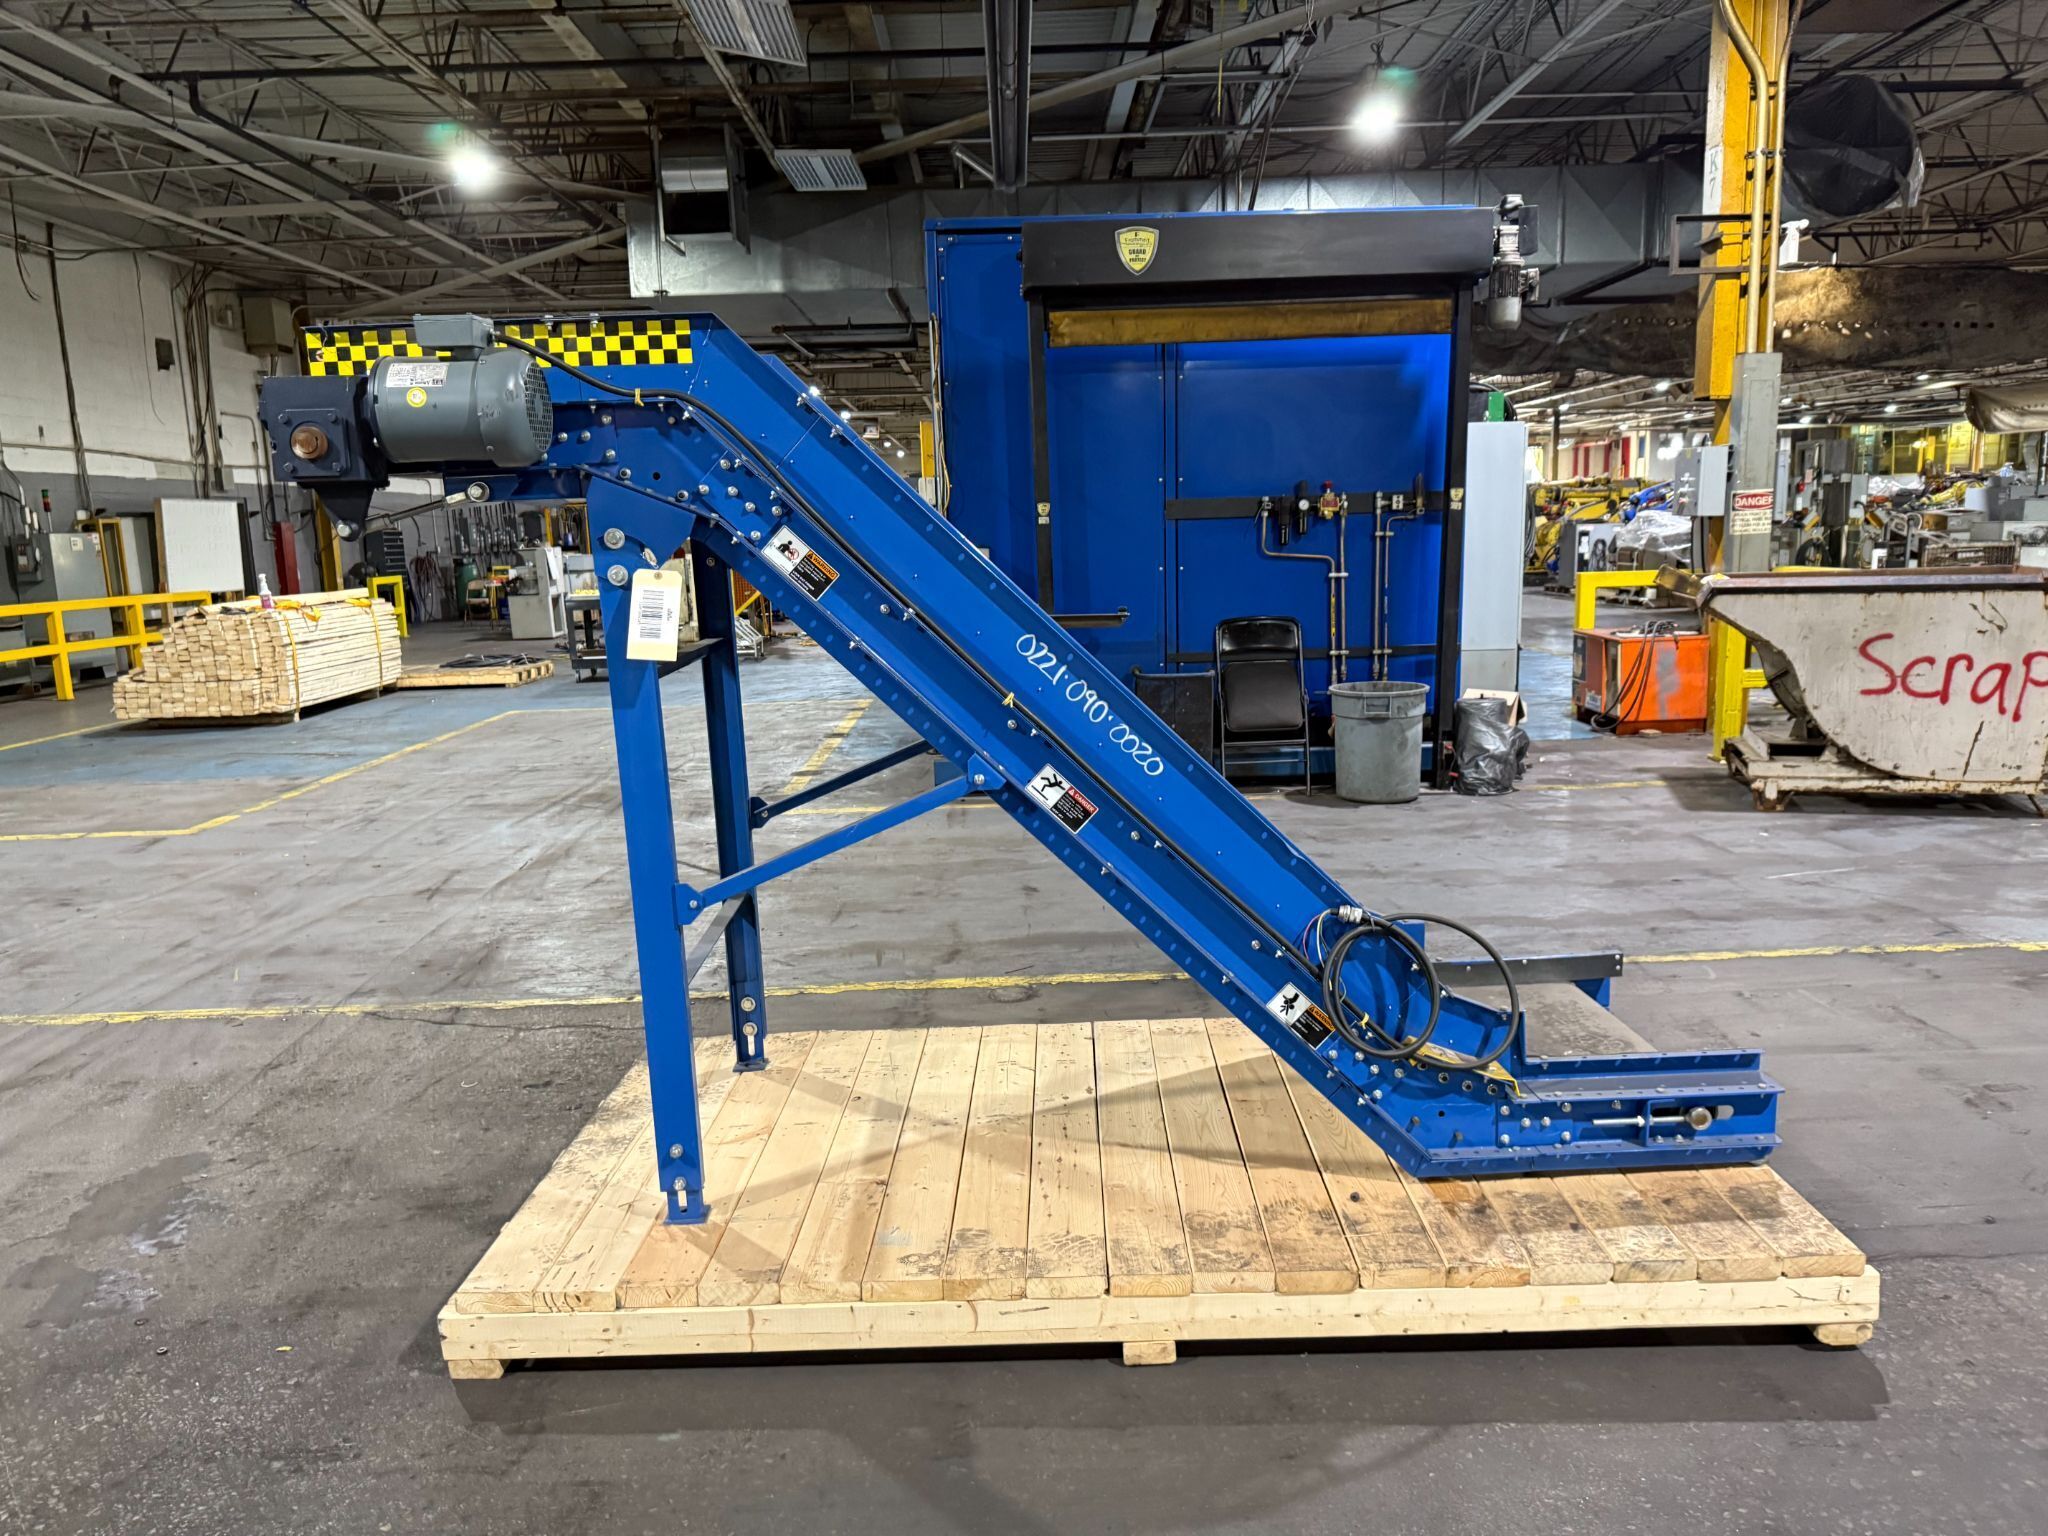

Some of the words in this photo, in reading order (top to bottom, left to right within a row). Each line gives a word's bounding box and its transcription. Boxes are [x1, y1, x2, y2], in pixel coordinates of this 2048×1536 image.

[1709, 151, 1719, 174] K
[812, 554, 836, 578] WARNING
[1858, 632, 2048, 722] Scrap
[1074, 793, 1096, 812] DANGER
